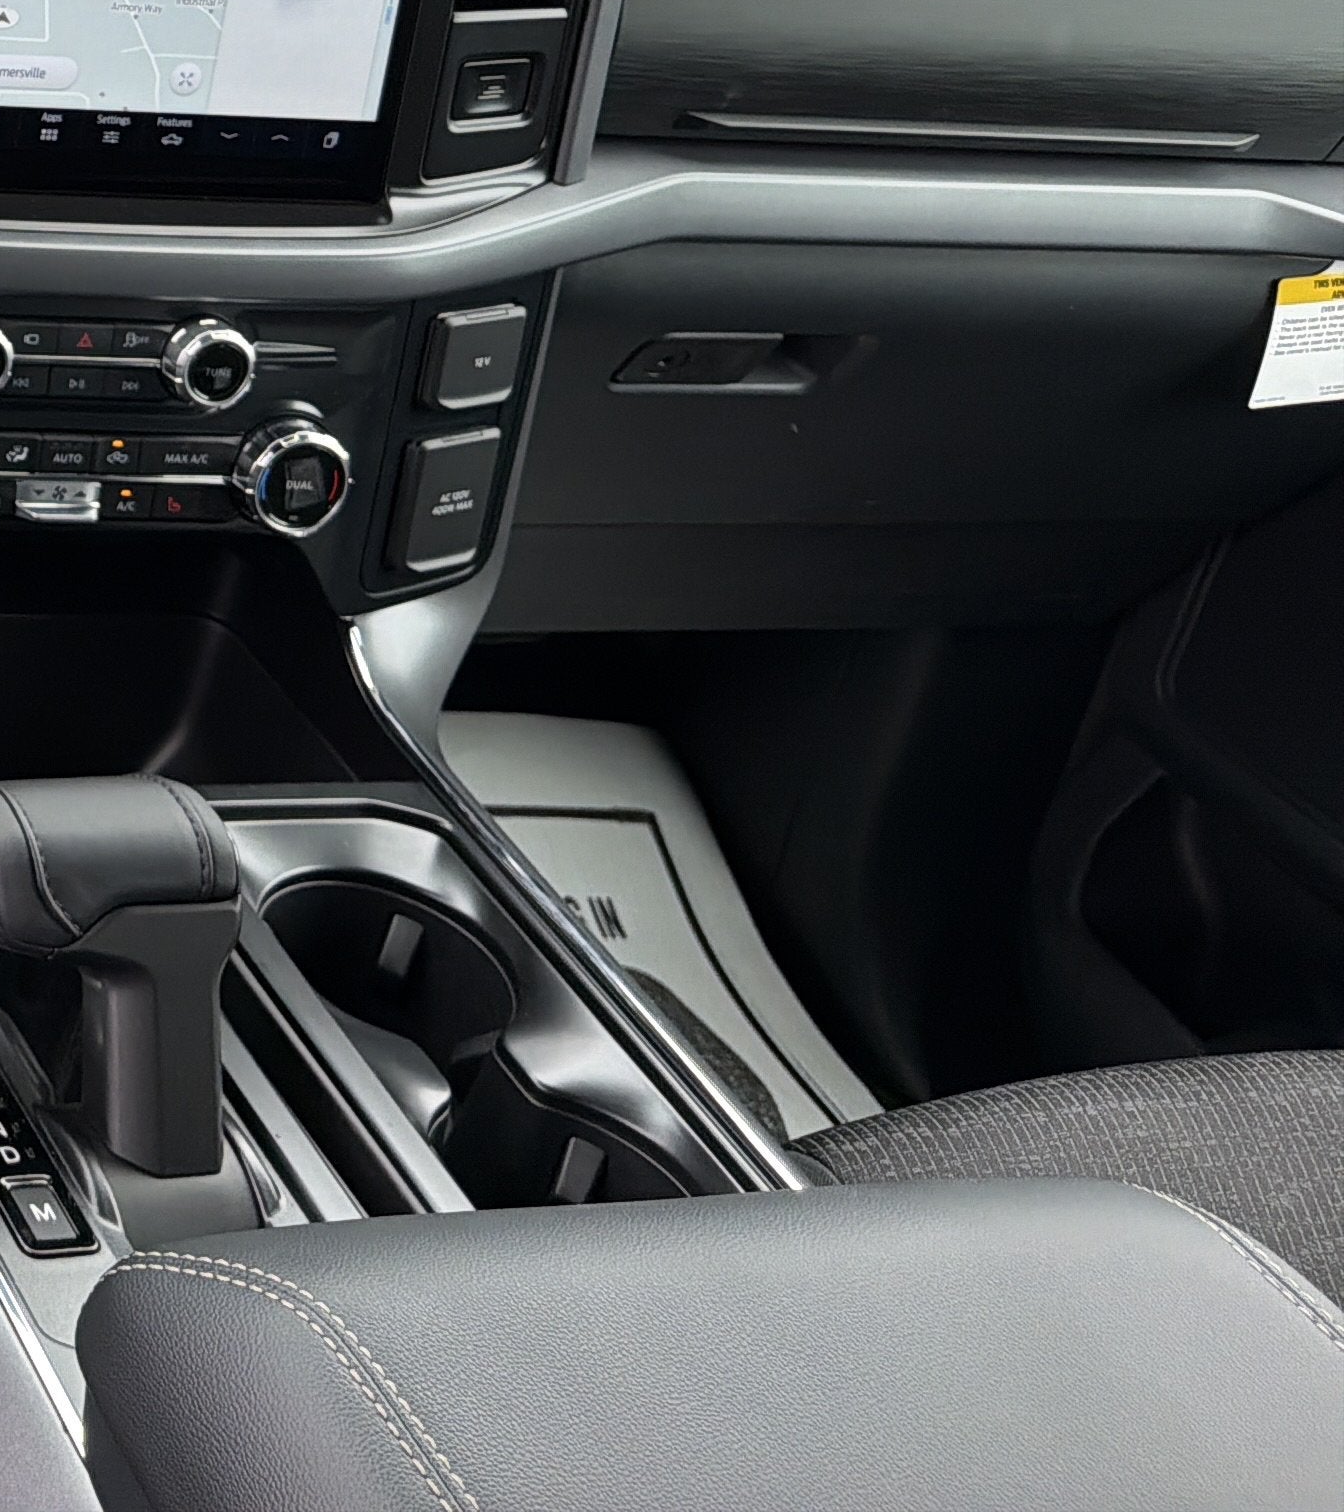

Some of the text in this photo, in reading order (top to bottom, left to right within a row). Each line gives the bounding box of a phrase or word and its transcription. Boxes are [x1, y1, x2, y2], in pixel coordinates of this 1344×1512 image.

[41, 111, 63, 124] Apps
[96, 113, 132, 128] Settings
[157, 117, 193, 129] Features
[53, 453, 83, 464] AUTO
[164, 453, 209, 465] MAX A/C
[285, 479, 314, 490] DUAL
[116, 500, 135, 512] A/C
[28, 1202, 58, 1223] M
